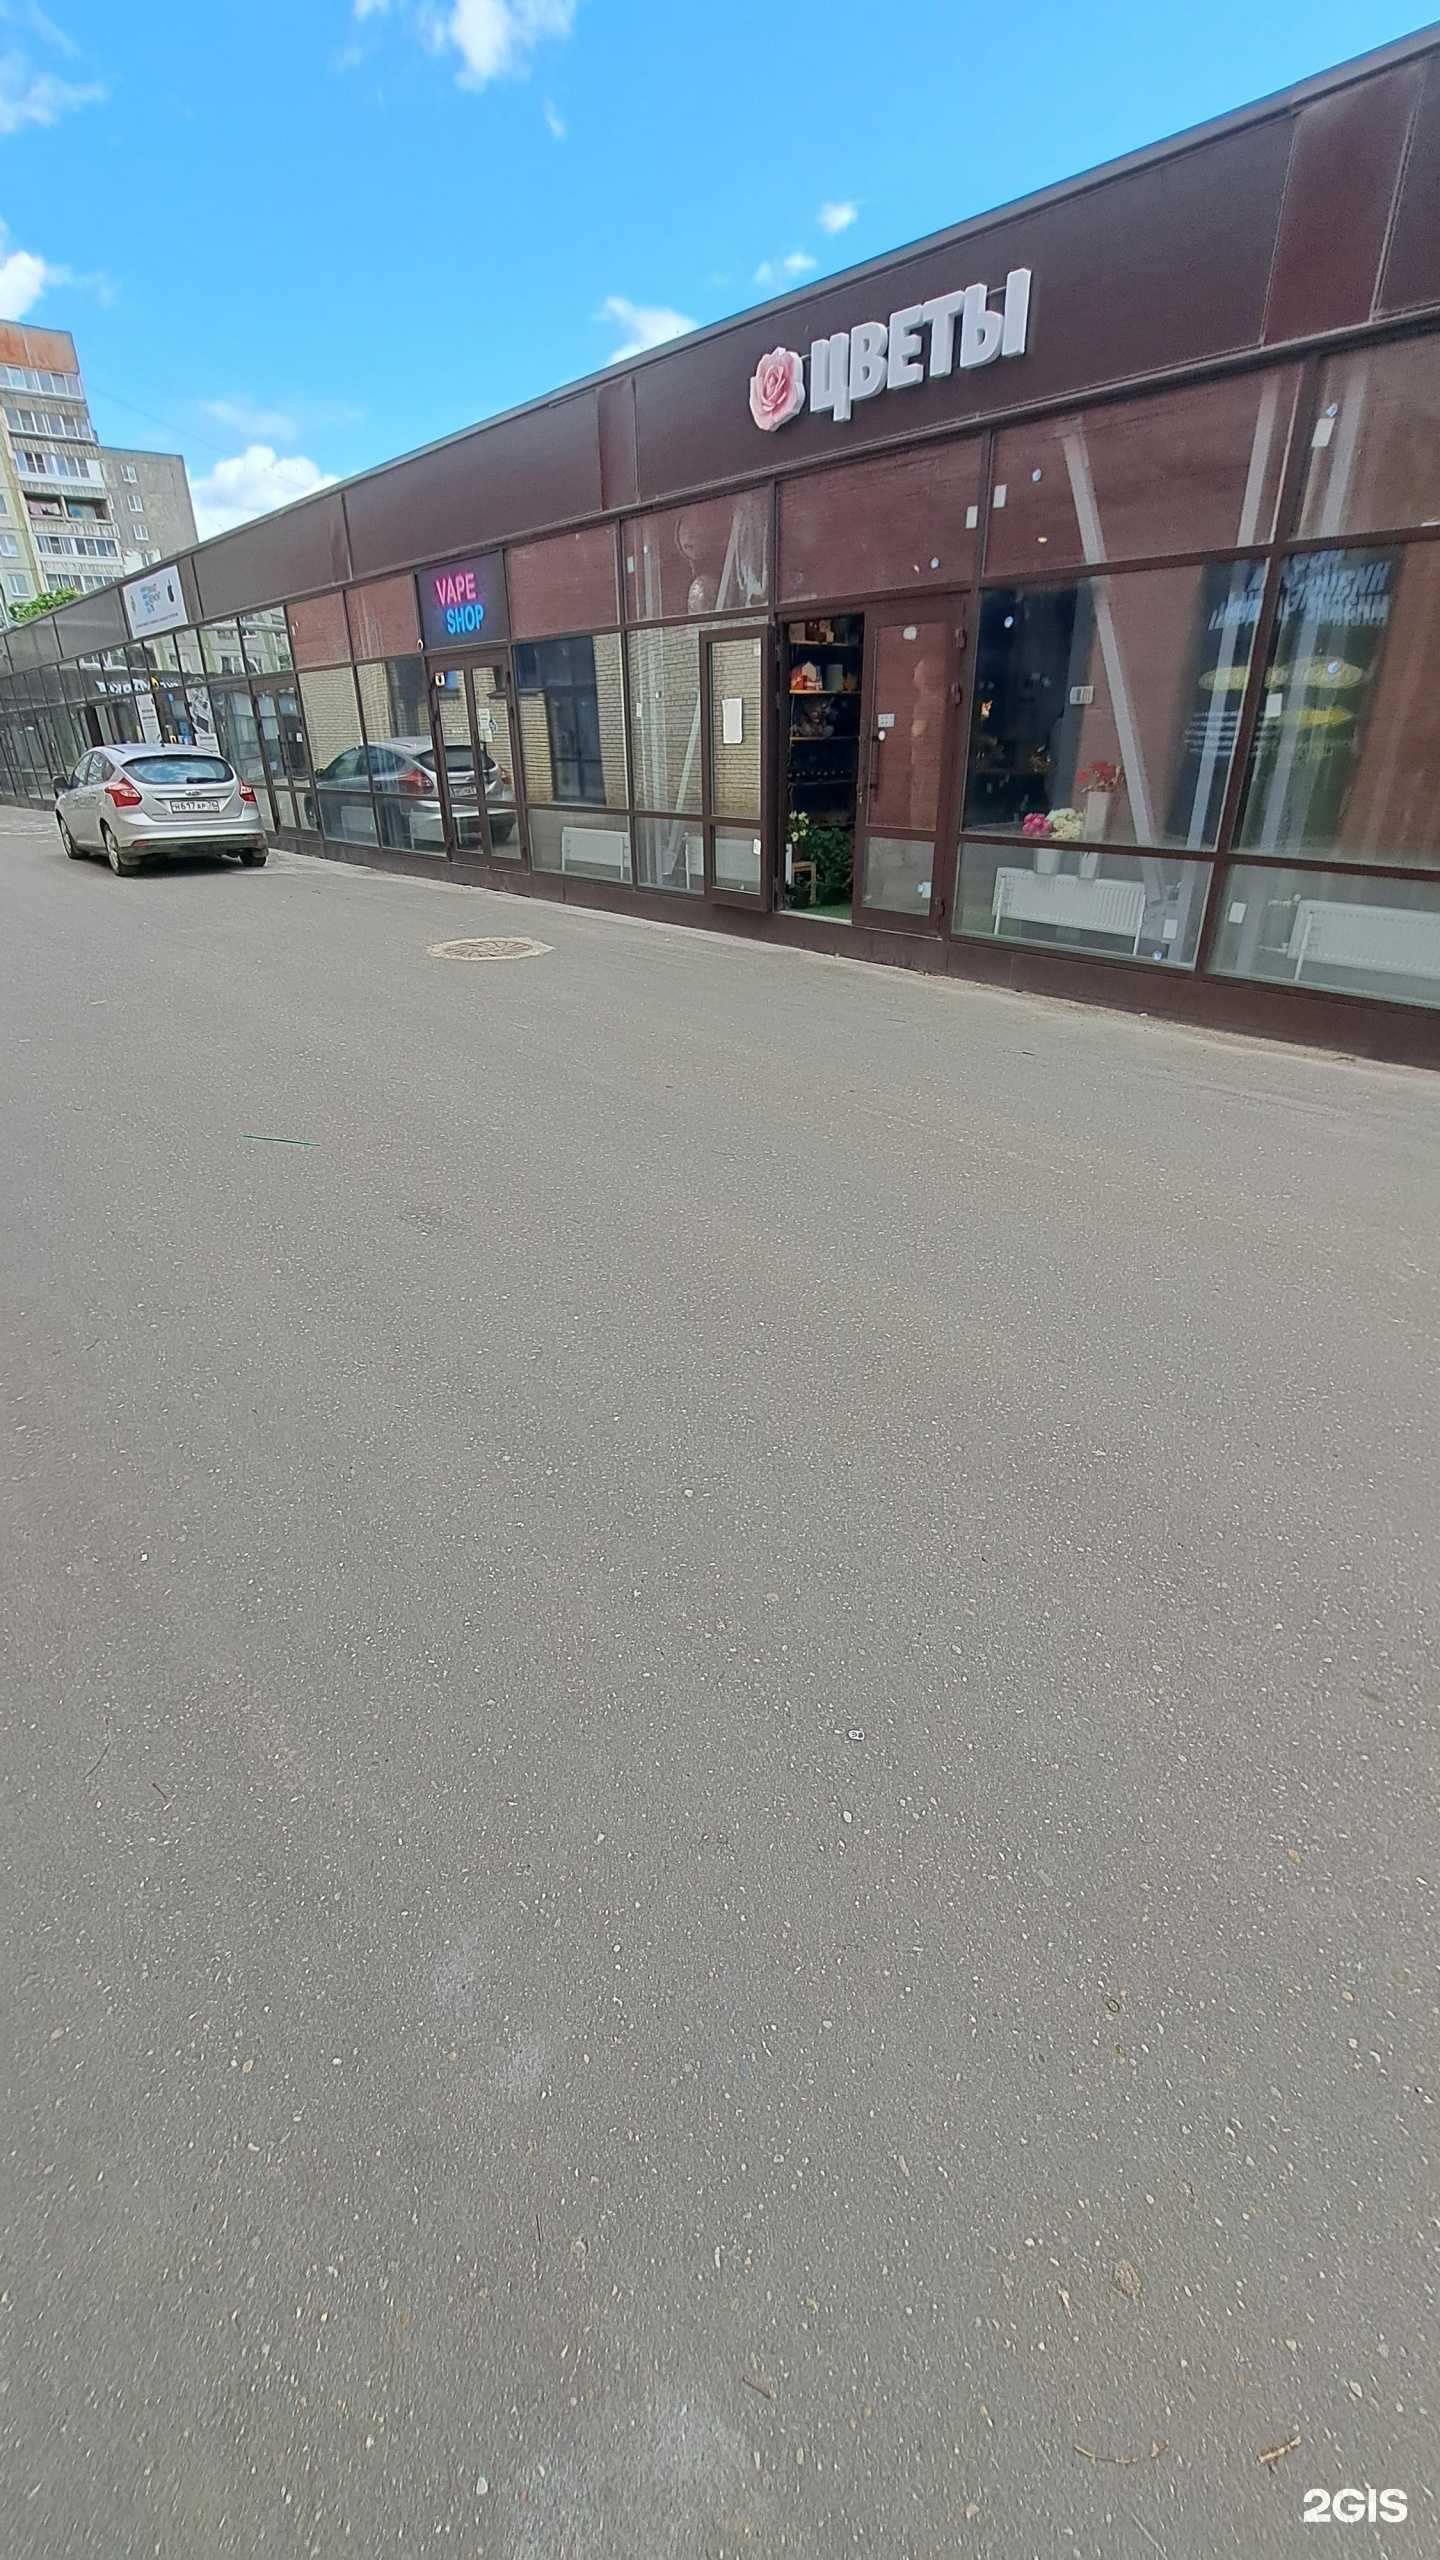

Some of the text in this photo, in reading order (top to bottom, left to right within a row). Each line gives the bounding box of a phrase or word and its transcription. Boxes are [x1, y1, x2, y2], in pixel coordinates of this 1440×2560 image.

[809, 267, 1032, 423] ЦВЕТЫ
[436, 572, 476, 606] VAPE
[446, 604, 484, 634] SHOP
